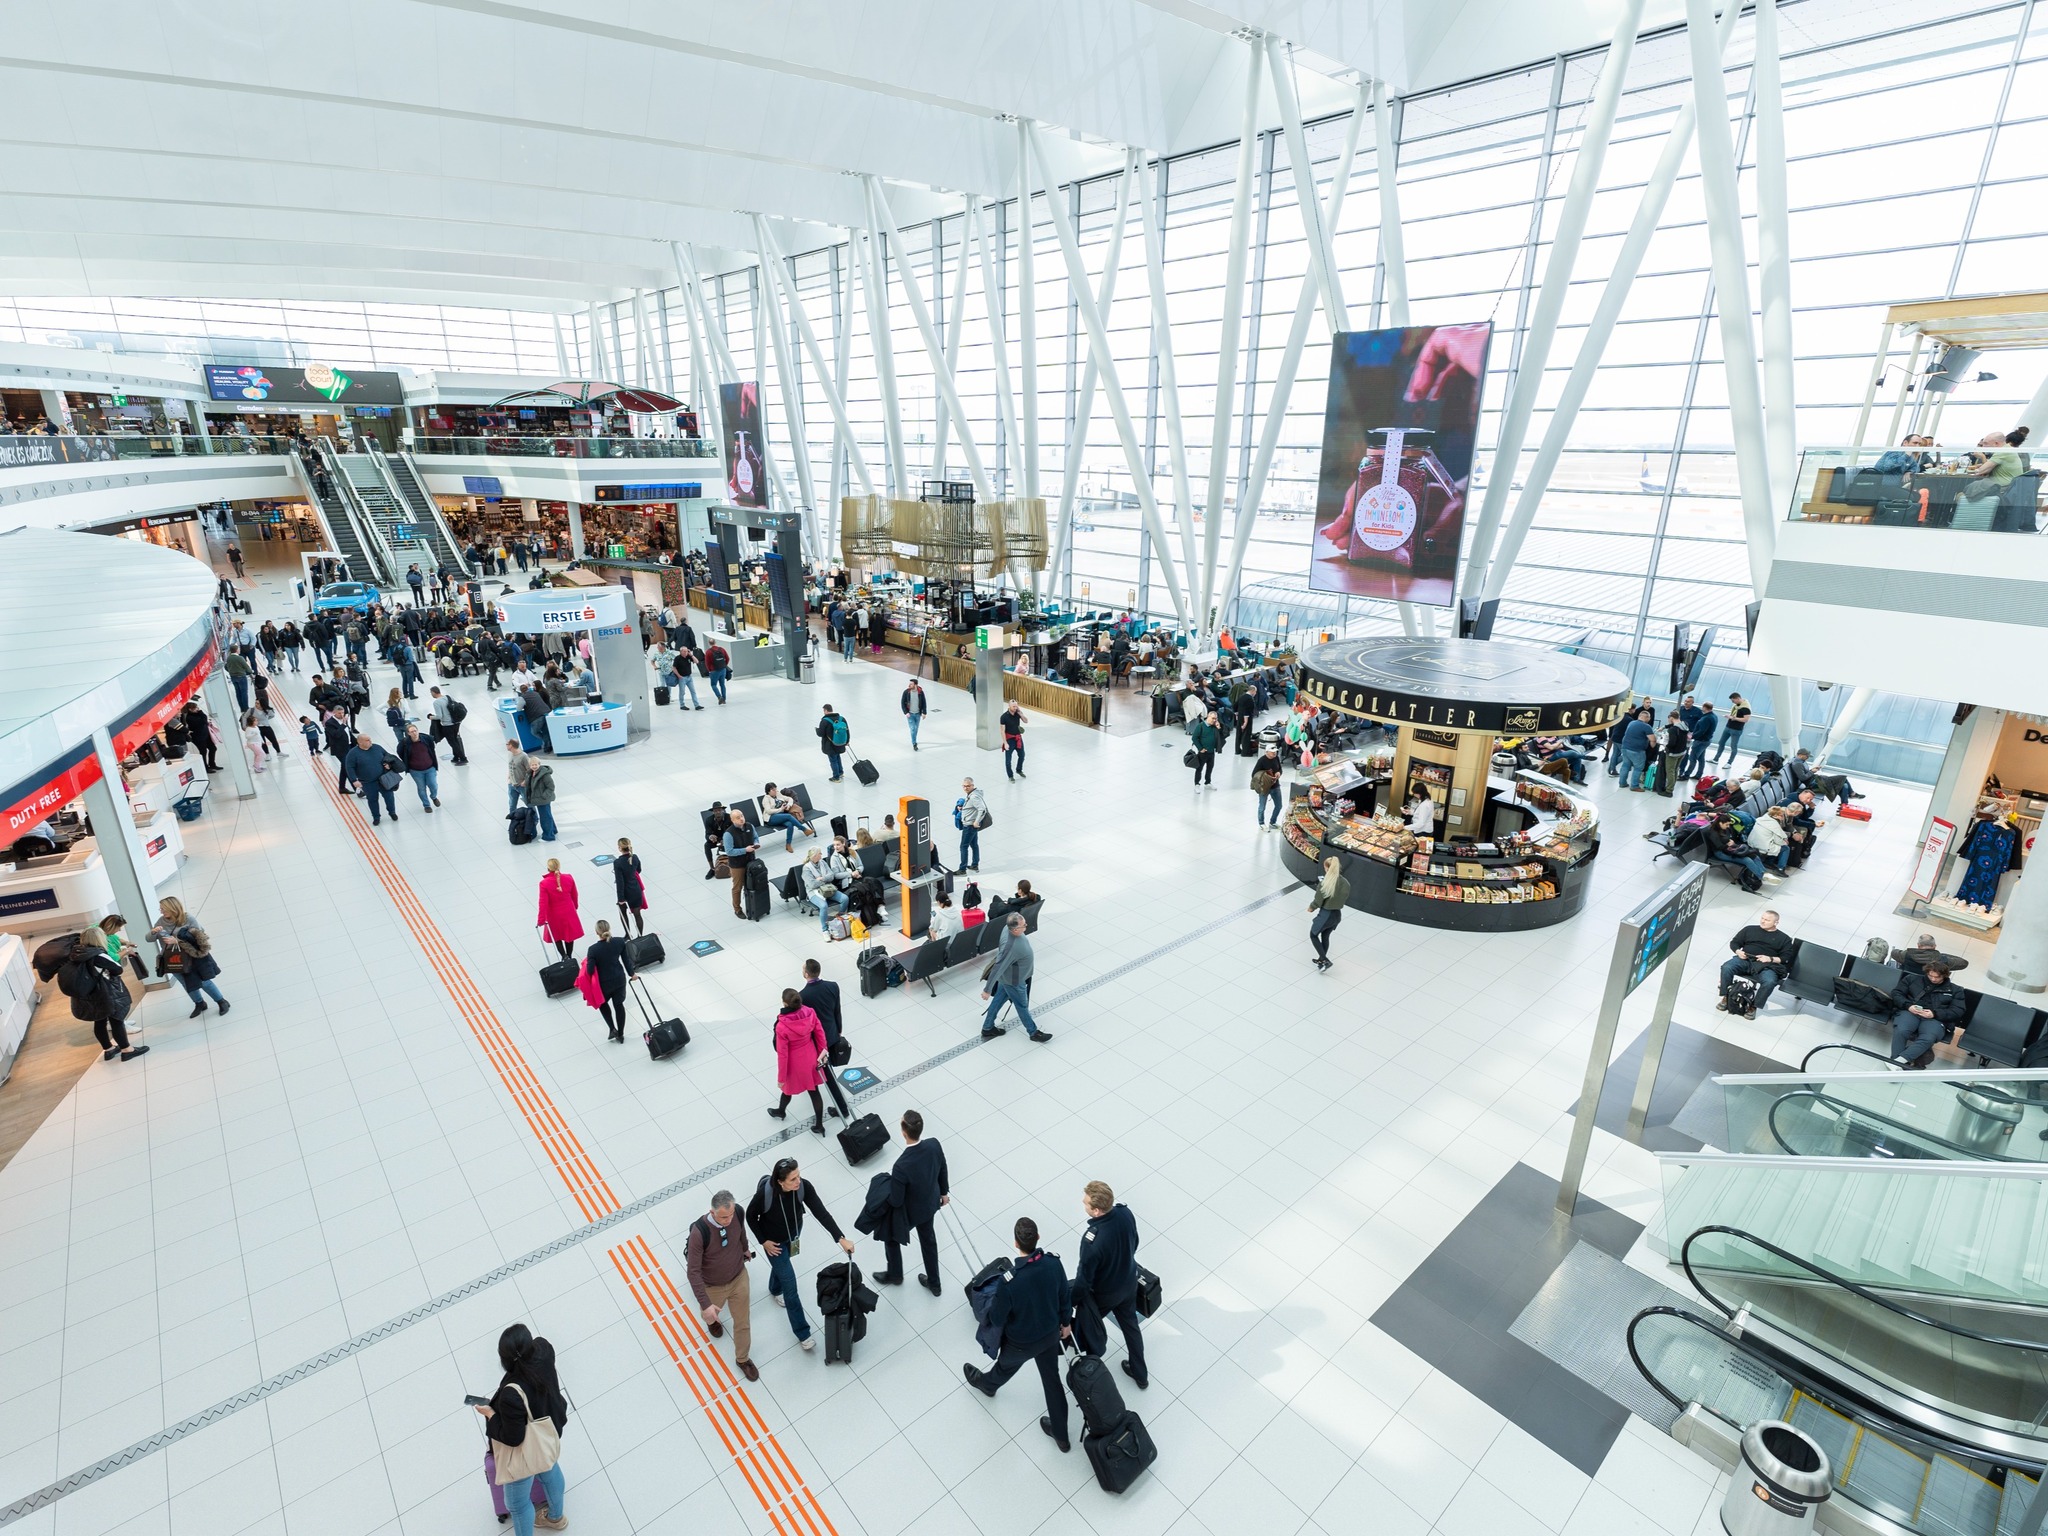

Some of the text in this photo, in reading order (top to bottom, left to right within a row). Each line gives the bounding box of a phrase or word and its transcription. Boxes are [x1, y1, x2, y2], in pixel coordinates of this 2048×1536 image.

[309, 367, 329, 376] food
[757, 516, 763, 525] A
[543, 611, 581, 623] ERSTE
[598, 628, 623, 636] ERSTE
[157, 691, 183, 720] TRAVEL VALUE
[1307, 677, 1476, 727] CHOCOLATIER
[567, 723, 600, 734] ERSTE
[10, 787, 61, 829] DUTY FREE
[0, 898, 47, 910] HEINEMANN
